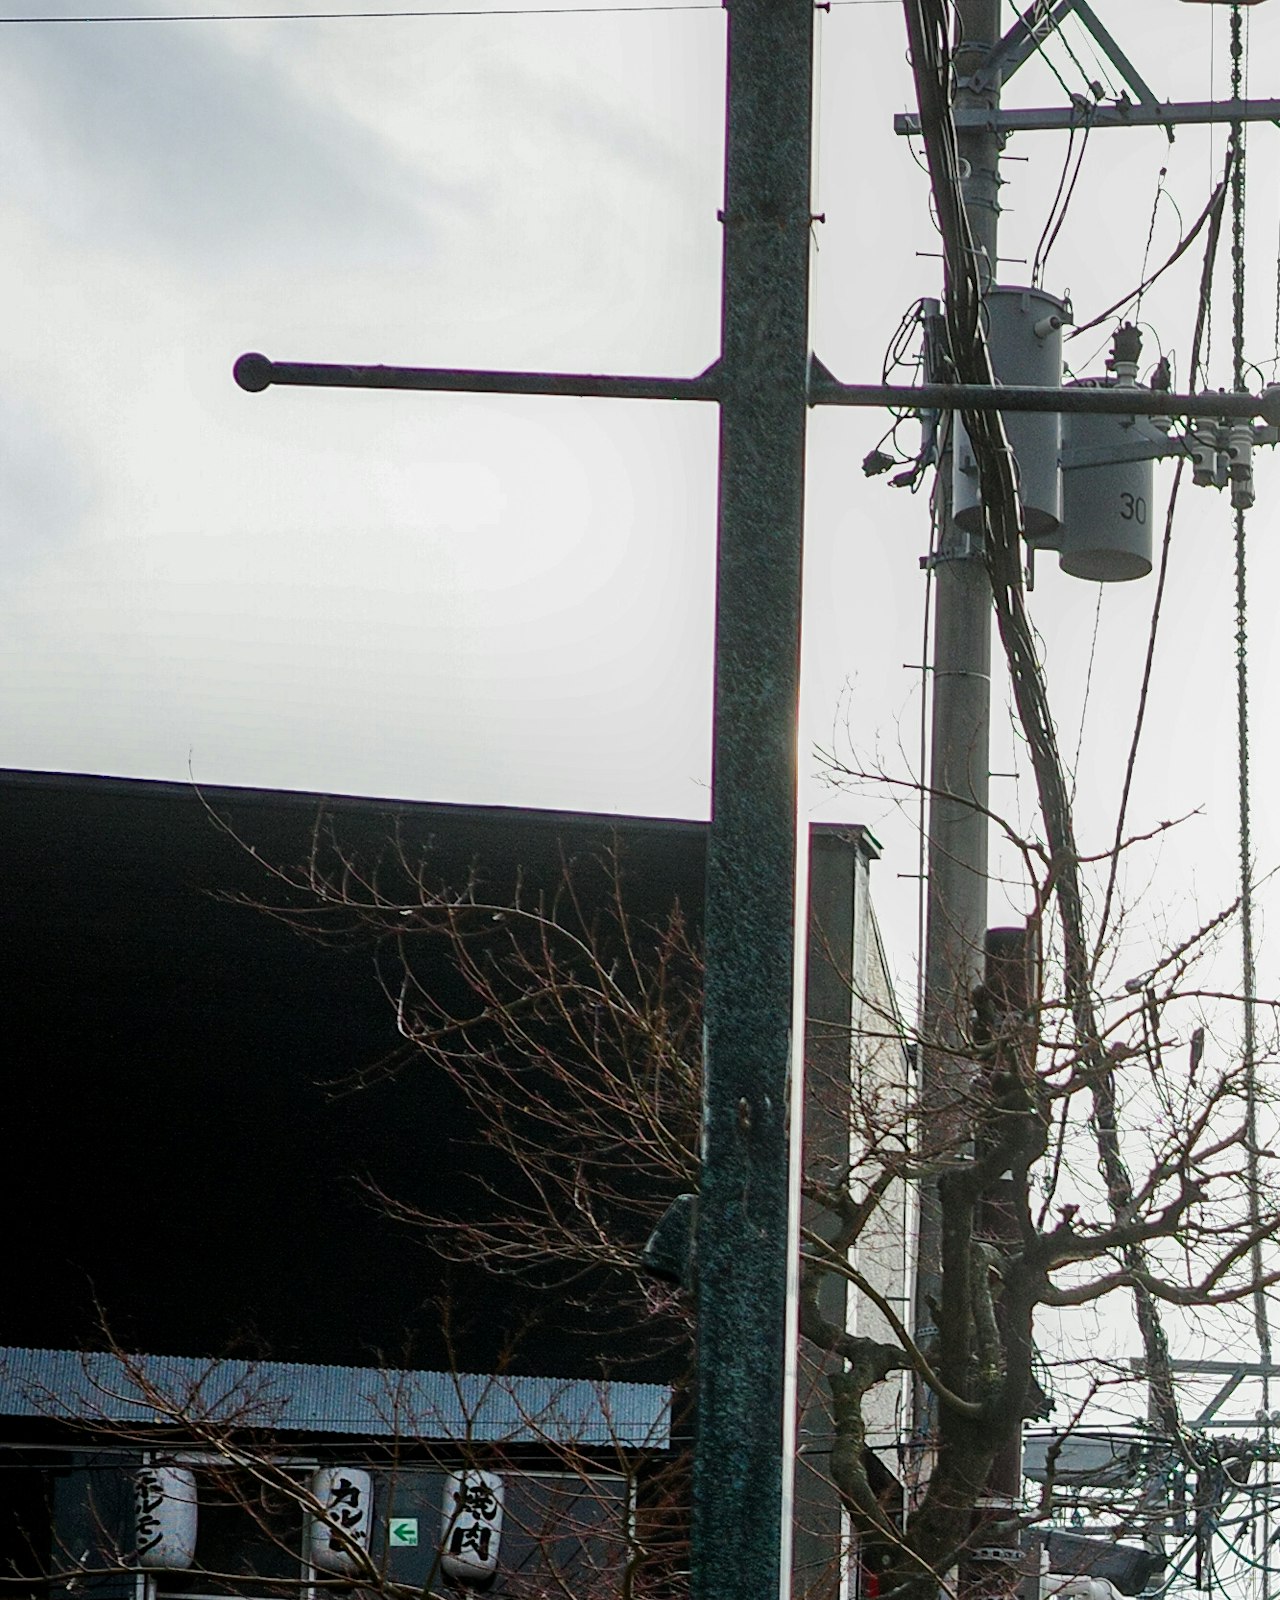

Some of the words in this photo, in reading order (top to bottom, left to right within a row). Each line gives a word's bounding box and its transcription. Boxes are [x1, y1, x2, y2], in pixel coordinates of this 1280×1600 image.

[1119, 491, 1147, 525] 30
[330, 1477, 366, 1553] カルビ
[451, 1481, 498, 1562] 焼肉
